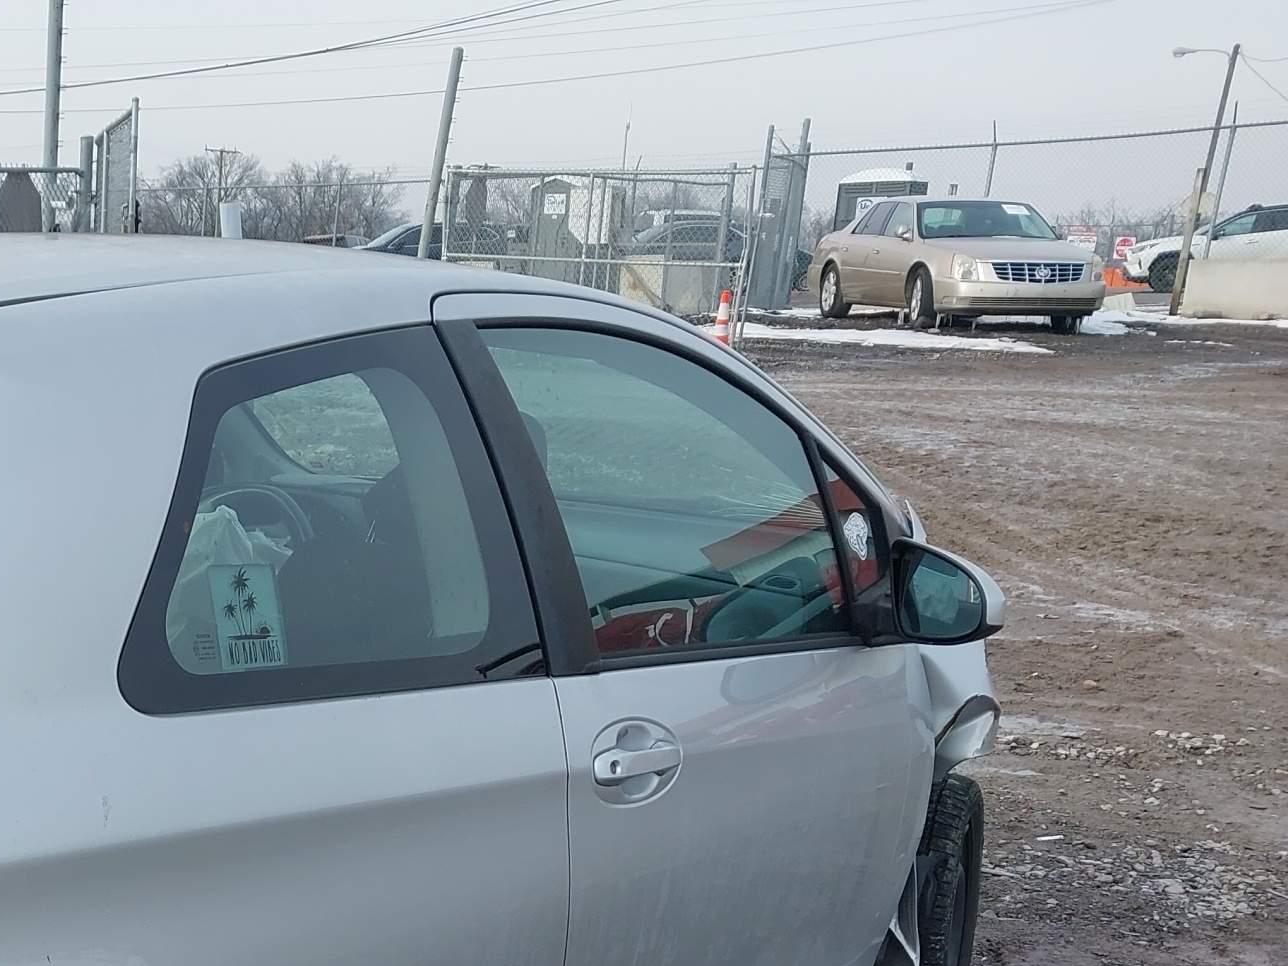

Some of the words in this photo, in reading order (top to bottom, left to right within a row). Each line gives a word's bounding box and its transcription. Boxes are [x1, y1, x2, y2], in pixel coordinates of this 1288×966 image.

[228, 640, 240, 665] NO
[242, 640, 258, 664] BAD
[260, 639, 281, 663] VIBES
